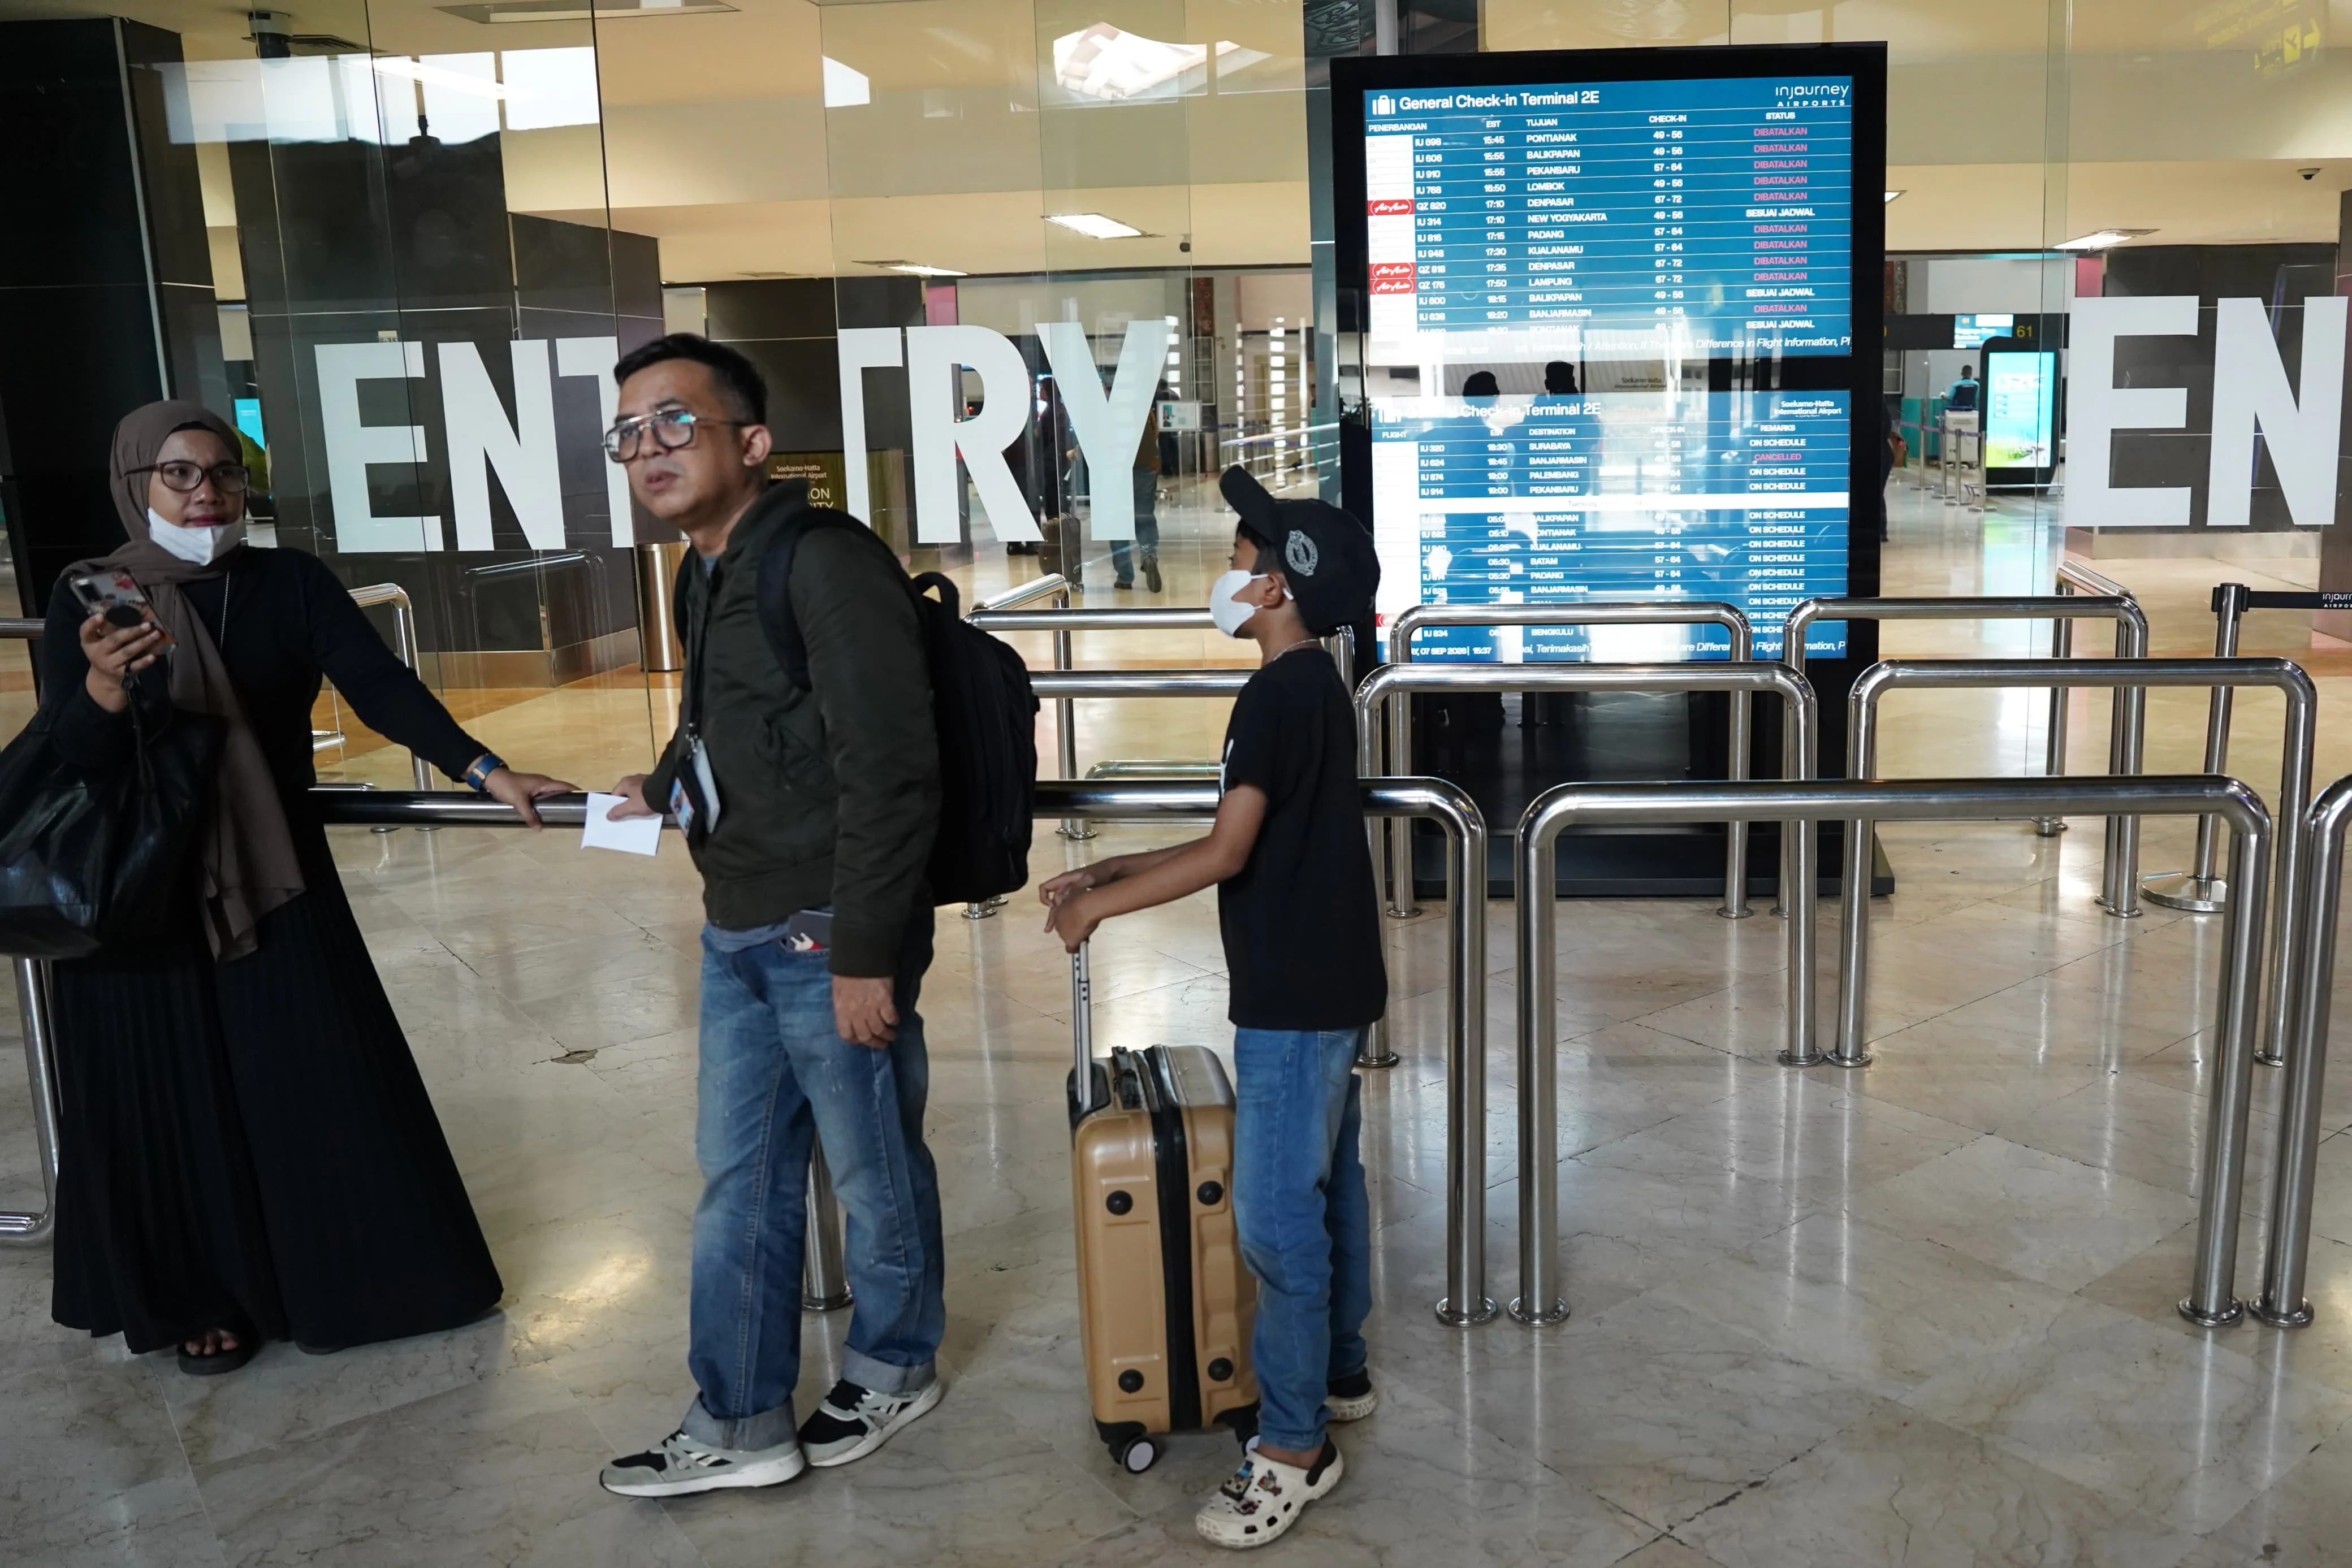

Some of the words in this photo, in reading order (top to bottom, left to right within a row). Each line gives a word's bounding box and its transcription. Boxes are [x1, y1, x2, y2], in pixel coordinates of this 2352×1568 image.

[1775, 85, 1849, 99] injourney
[1399, 96, 1452, 110] General
[1456, 93, 1517, 108] Check-in
[1520, 91, 1578, 106] Terminal
[1581, 90, 1599, 103] 2E
[1368, 123, 1428, 132] PENERBANGAN
[1484, 136, 1504, 144] 15:45
[1527, 150, 1580, 159] BALIKPAPAN
[1527, 166, 1580, 175] PEKANBARU
[1754, 176, 1807, 185] DIBATALKAN
[1416, 202, 1429, 211] QZ
[1550, 213, 1607, 222] YOGYAKARTA
[1778, 208, 1815, 216] JADWAL
[1528, 246, 1583, 254] KUALANAMU
[1529, 262, 1575, 270] DENPASAR
[1529, 278, 1572, 286] LAMPUNG
[1754, 272, 1807, 281] DIBATALKAN
[1419, 297, 1428, 305] IU
[1746, 289, 1777, 297] SESUAI
[1754, 305, 1807, 313] DIBATALKAN
[2016, 325, 2033, 337] 61
[1594, 341, 1638, 351] Attention,
[1696, 339, 1744, 348] Difference
[1747, 339, 1754, 348] in
[1757, 338, 1783, 349] Flight
[1785, 337, 1838, 348] Information,
[1461, 405, 1521, 417] Check-in
[1526, 403, 1580, 416] Terminal
[1583, 402, 1601, 414] 2E
[1537, 644, 1589, 653] Terimakasih
[1756, 642, 1782, 652] Flight
